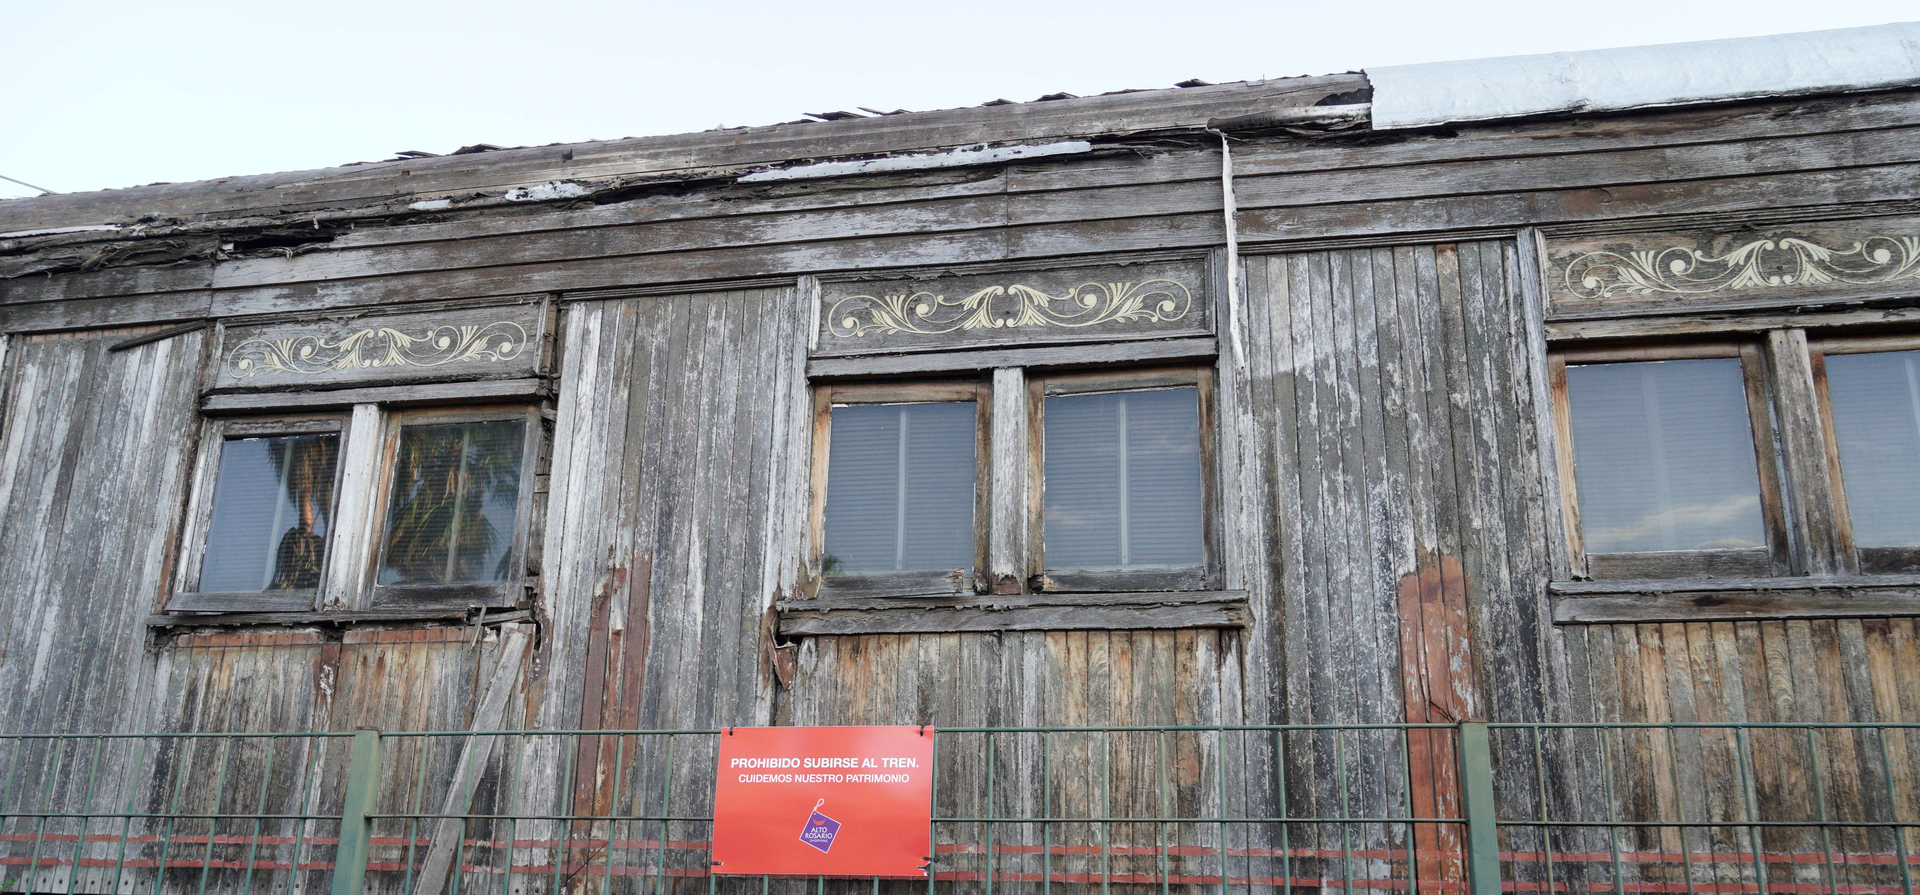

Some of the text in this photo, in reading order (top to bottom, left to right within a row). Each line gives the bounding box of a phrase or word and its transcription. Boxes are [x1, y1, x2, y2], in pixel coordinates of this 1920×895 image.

[730, 757, 920, 769] PROHIBIDO SUBIRSE AL TREN.
[738, 774, 910, 783] CUIDEMOS NUESTRO PATRIMONIO
